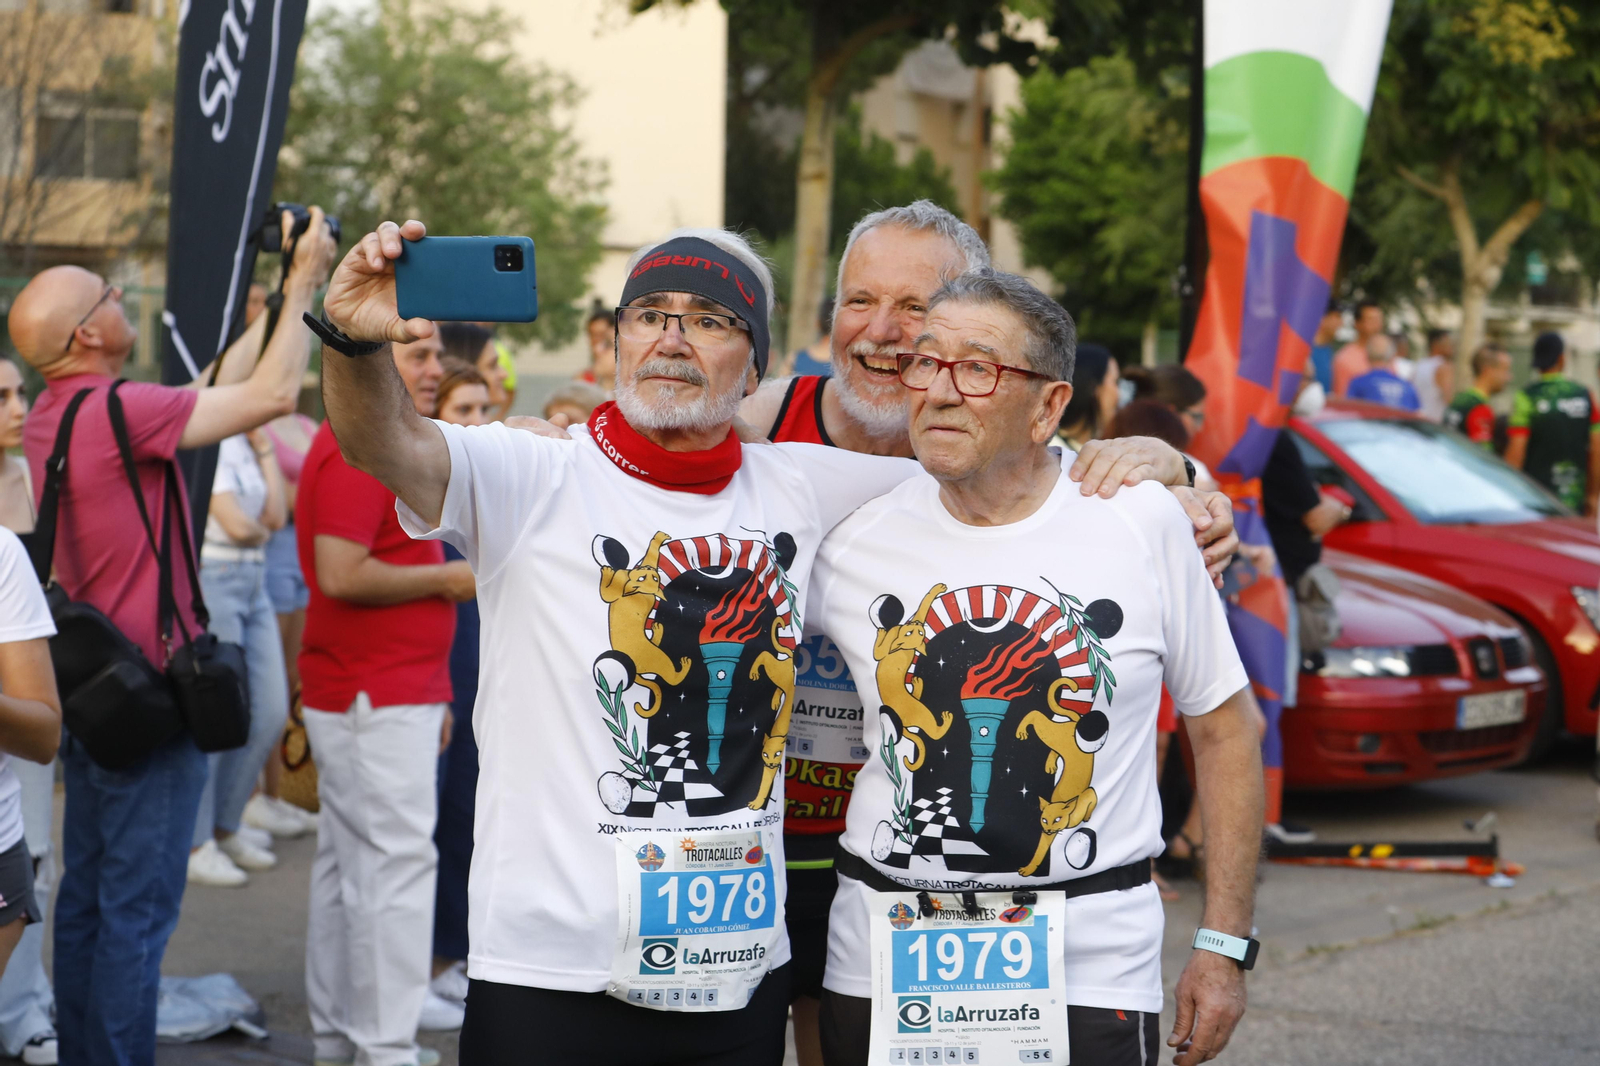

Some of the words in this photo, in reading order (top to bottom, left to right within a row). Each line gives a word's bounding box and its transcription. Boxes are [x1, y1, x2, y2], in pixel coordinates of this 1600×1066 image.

[802, 743, 809, 751] 5
[597, 823, 619, 835] XIX
[685, 846, 743, 862] TROTACALLES
[658, 871, 766, 925] 1978
[674, 927, 693, 935] JUAN
[694, 925, 727, 934] COBACHO
[728, 923, 750, 931] GÓMEZ
[683, 943, 766, 965] laArruzafa
[908, 931, 1033, 982] 1979
[909, 984, 949, 992] FRANCISCO
[950, 983, 975, 991] VALLE
[976, 981, 1031, 990] BALLESTEROS
[708, 993, 714, 1001] 5
[938, 1003, 1040, 1023] laArruzafa
[932, 1051, 938, 1059] 3
[968, 1052, 974, 1060] 5
[1033, 1051, 1040, 1060] 5
